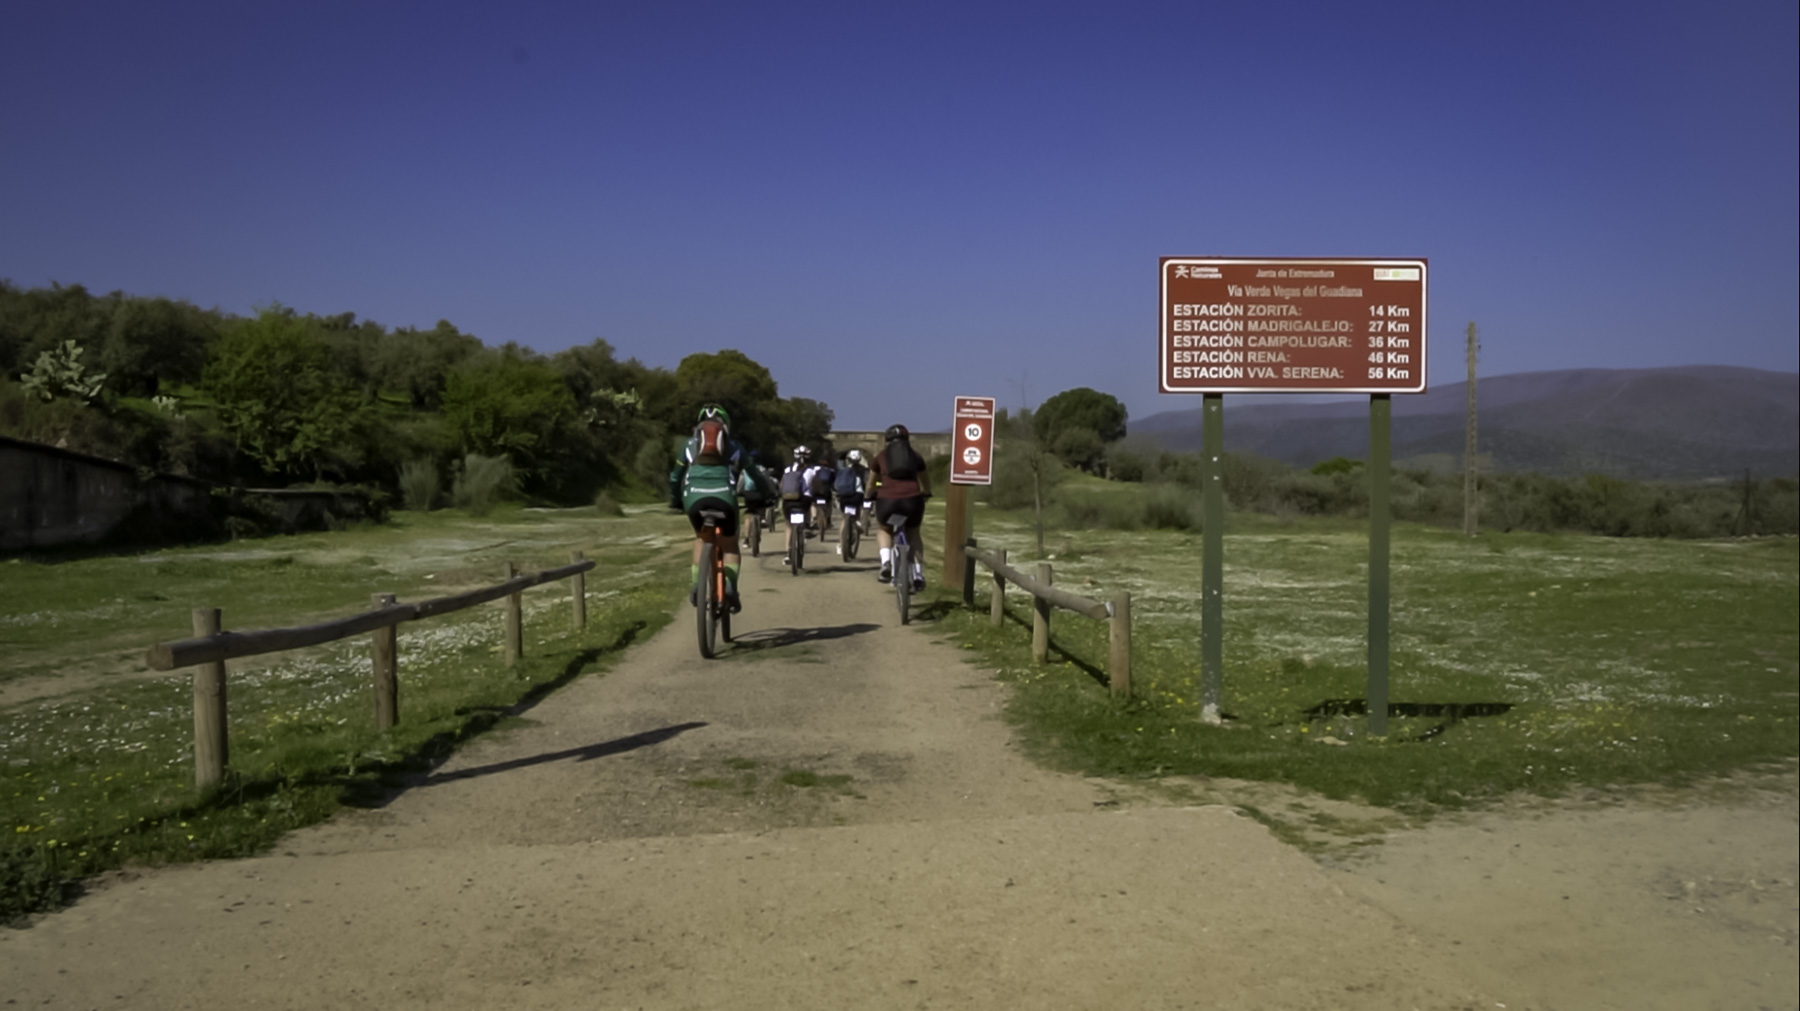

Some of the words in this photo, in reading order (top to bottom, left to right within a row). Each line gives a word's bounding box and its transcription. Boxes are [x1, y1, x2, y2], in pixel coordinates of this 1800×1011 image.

[1256, 269, 1276, 278] Junta
[1278, 269, 1287, 278] de
[1288, 269, 1335, 278] Extremadura
[1245, 286, 1271, 297] Verde
[1273, 286, 1301, 299] Vegas
[1303, 286, 1317, 297] del
[1319, 286, 1363, 297] Guadiana
[1174, 302, 1243, 317] ESTACIÓN
[1247, 305, 1302, 317] ZORITA:
[1368, 306, 1383, 317] 14
[1387, 306, 1409, 317] Km
[1174, 318, 1243, 332] ESTACIÓN
[1247, 321, 1353, 332] MADRIGALEJO:
[1368, 321, 1383, 332] 27
[1387, 321, 1409, 332] Km
[1174, 334, 1243, 347] ESTACIÓN
[1247, 337, 1351, 347] CAMPOLUGAR:
[1368, 337, 1383, 347] 36
[1387, 337, 1409, 347] Km
[1174, 349, 1243, 363] ESTACIÓN
[1247, 352, 1290, 363] RENA:
[1368, 353, 1383, 363] 46
[1387, 353, 1409, 363] Km
[1174, 365, 1243, 379] ESTACIÓN
[1247, 368, 1278, 379] VVA.
[1283, 367, 1344, 379] SERENA:
[1368, 368, 1383, 379] 56
[1387, 368, 1409, 379] Km
[968, 428, 979, 436] 10
